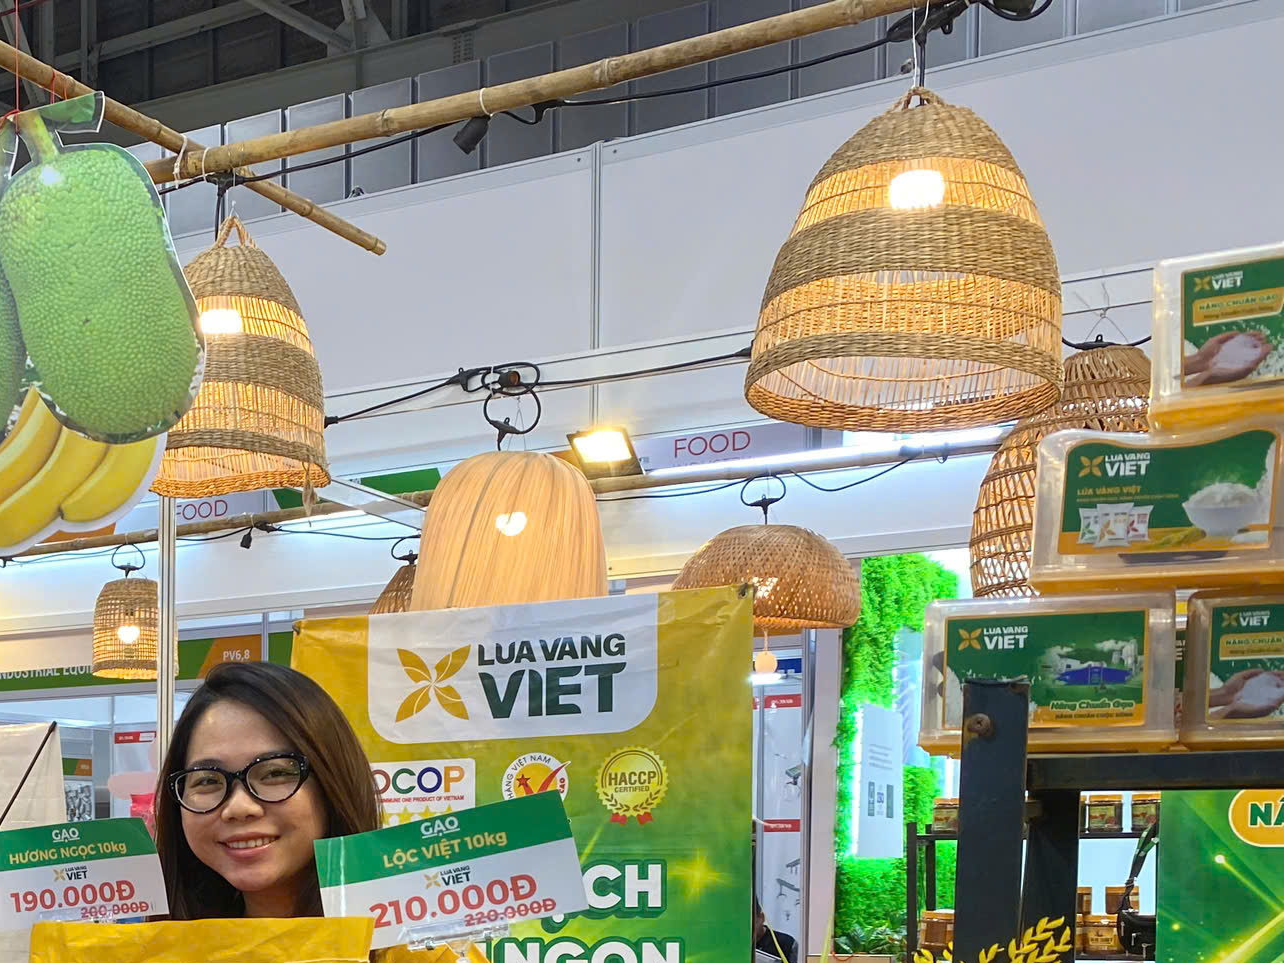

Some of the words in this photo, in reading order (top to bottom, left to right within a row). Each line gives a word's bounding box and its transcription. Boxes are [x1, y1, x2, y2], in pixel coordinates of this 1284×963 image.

[1212, 277, 1243, 290] VIET
[674, 431, 751, 458] FOOD
[1105, 461, 1150, 477] VIET
[1239, 616, 1270, 626] VIET
[1004, 626, 1028, 634] VANG
[478, 640, 536, 667] LUA
[538, 632, 626, 662] VANG
[984, 634, 1028, 650] VIET
[223, 650, 250, 660] PV6,8
[478, 661, 627, 719] VIET
[608, 770, 656, 787] HACCP
[614, 785, 650, 794] CERTIFIED
[52, 828, 80, 843] GẠO
[9, 848, 57, 864] HƯƠNG
[60, 844, 95, 859] NGỌC
[98, 841, 127, 855] 10kg
[383, 849, 419, 869] LỘC
[421, 838, 461, 859] VIỆT
[464, 831, 508, 850] 10kg
[66, 871, 88, 881] VIET
[441, 872, 471, 887] VIET
[10, 879, 135, 913] 190.000Đ
[369, 874, 537, 929] 210.000Đ
